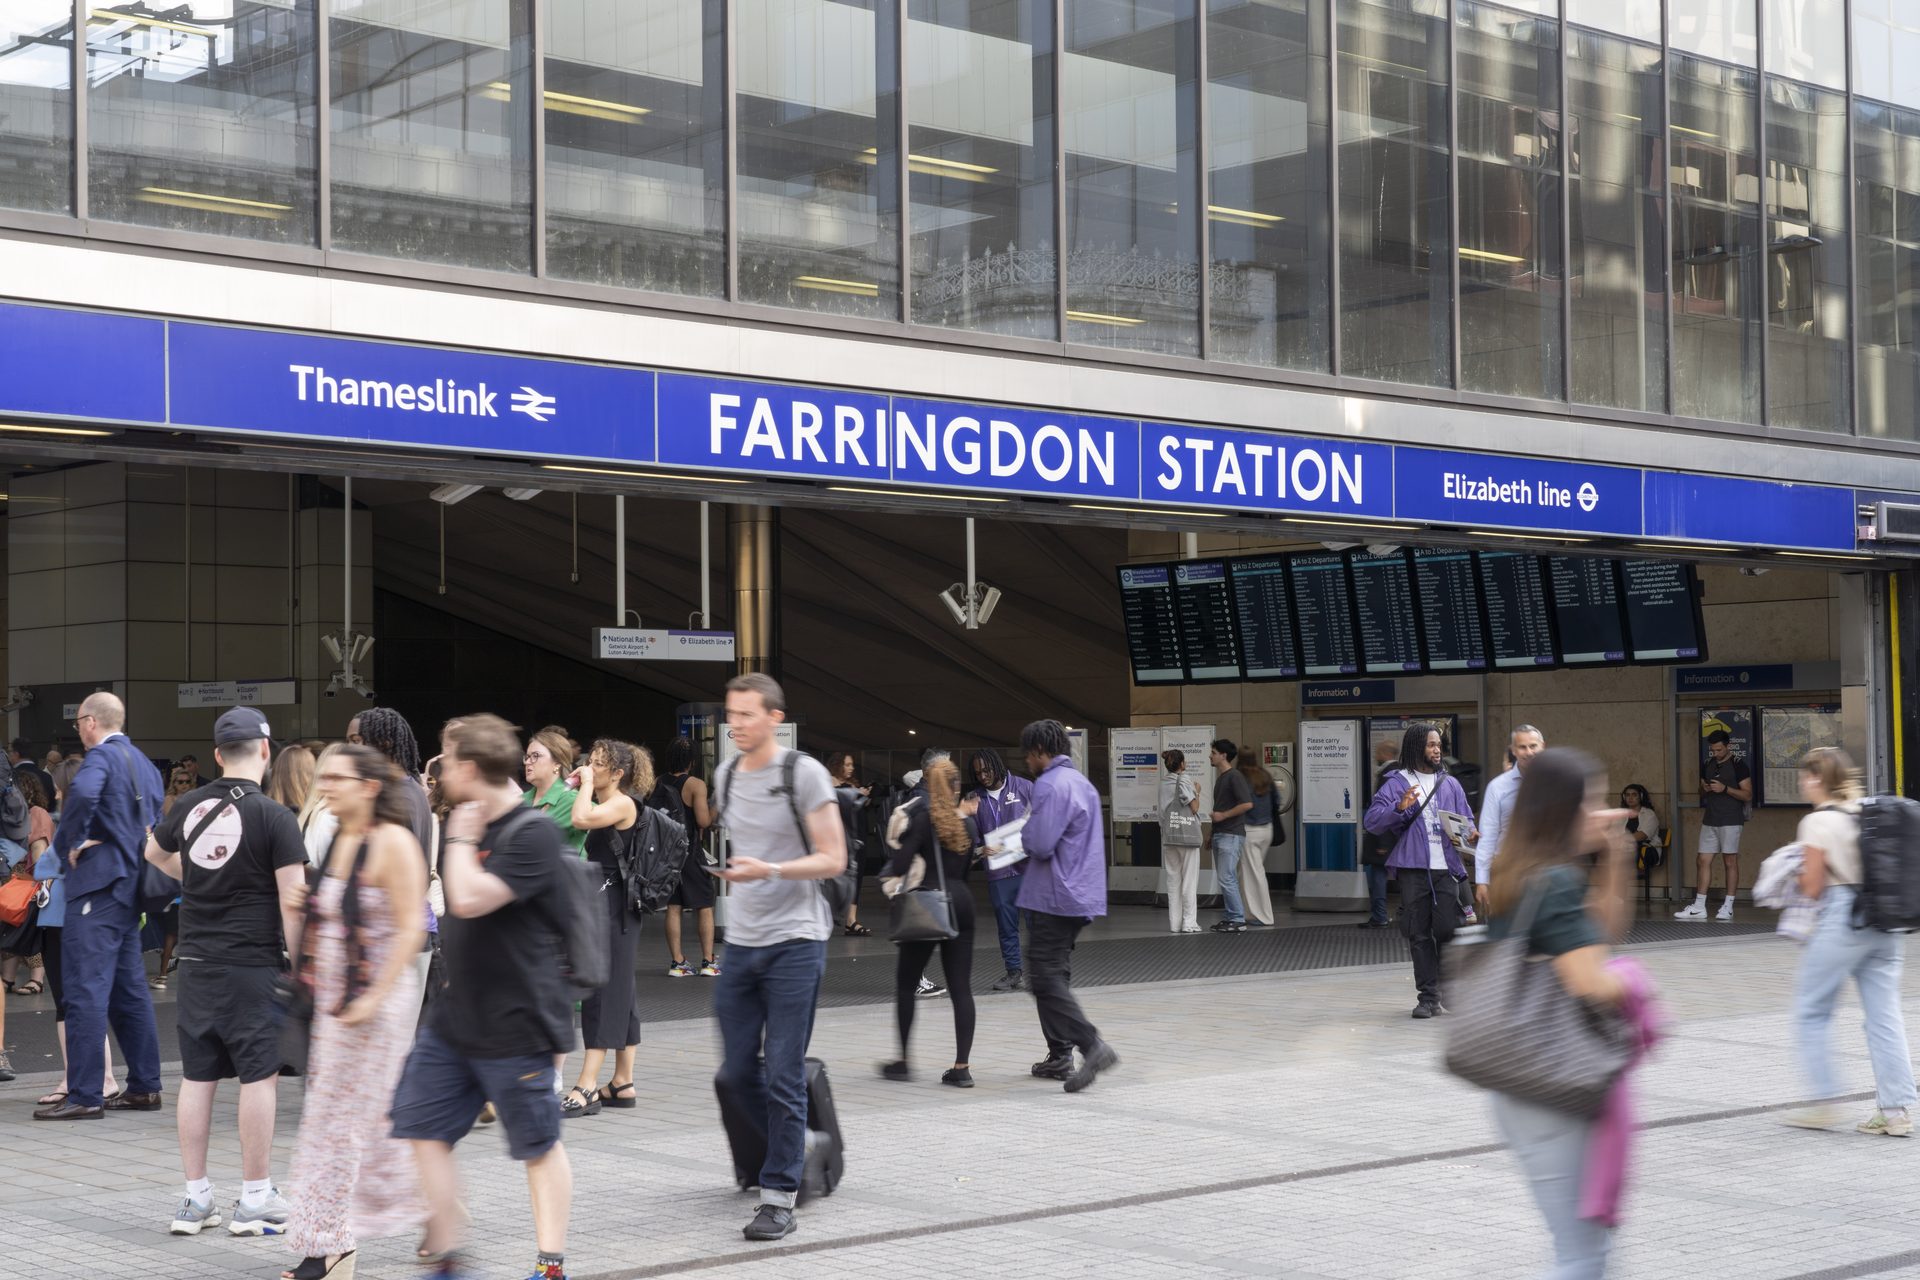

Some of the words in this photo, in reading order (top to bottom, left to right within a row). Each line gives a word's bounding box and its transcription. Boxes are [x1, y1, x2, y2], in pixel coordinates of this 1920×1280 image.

[289, 364, 499, 419] Thameslink
[710, 392, 1115, 487] FARRINGDON
[1157, 435, 1364, 506] STATION
[1443, 472, 1532, 506] Elizabeth
[1537, 480, 1571, 508] line
[1312, 556, 1341, 564] Departures
[1252, 561, 1280, 569] Departures
[608, 635, 634, 643] National
[635, 635, 647, 643] Rail
[688, 637, 716, 645] Elizabeth
[627, 643, 644, 651] Airport
[623, 649, 640, 657] Airport
[1684, 673, 1735, 685] Information
[1308, 687, 1349, 698] Information
